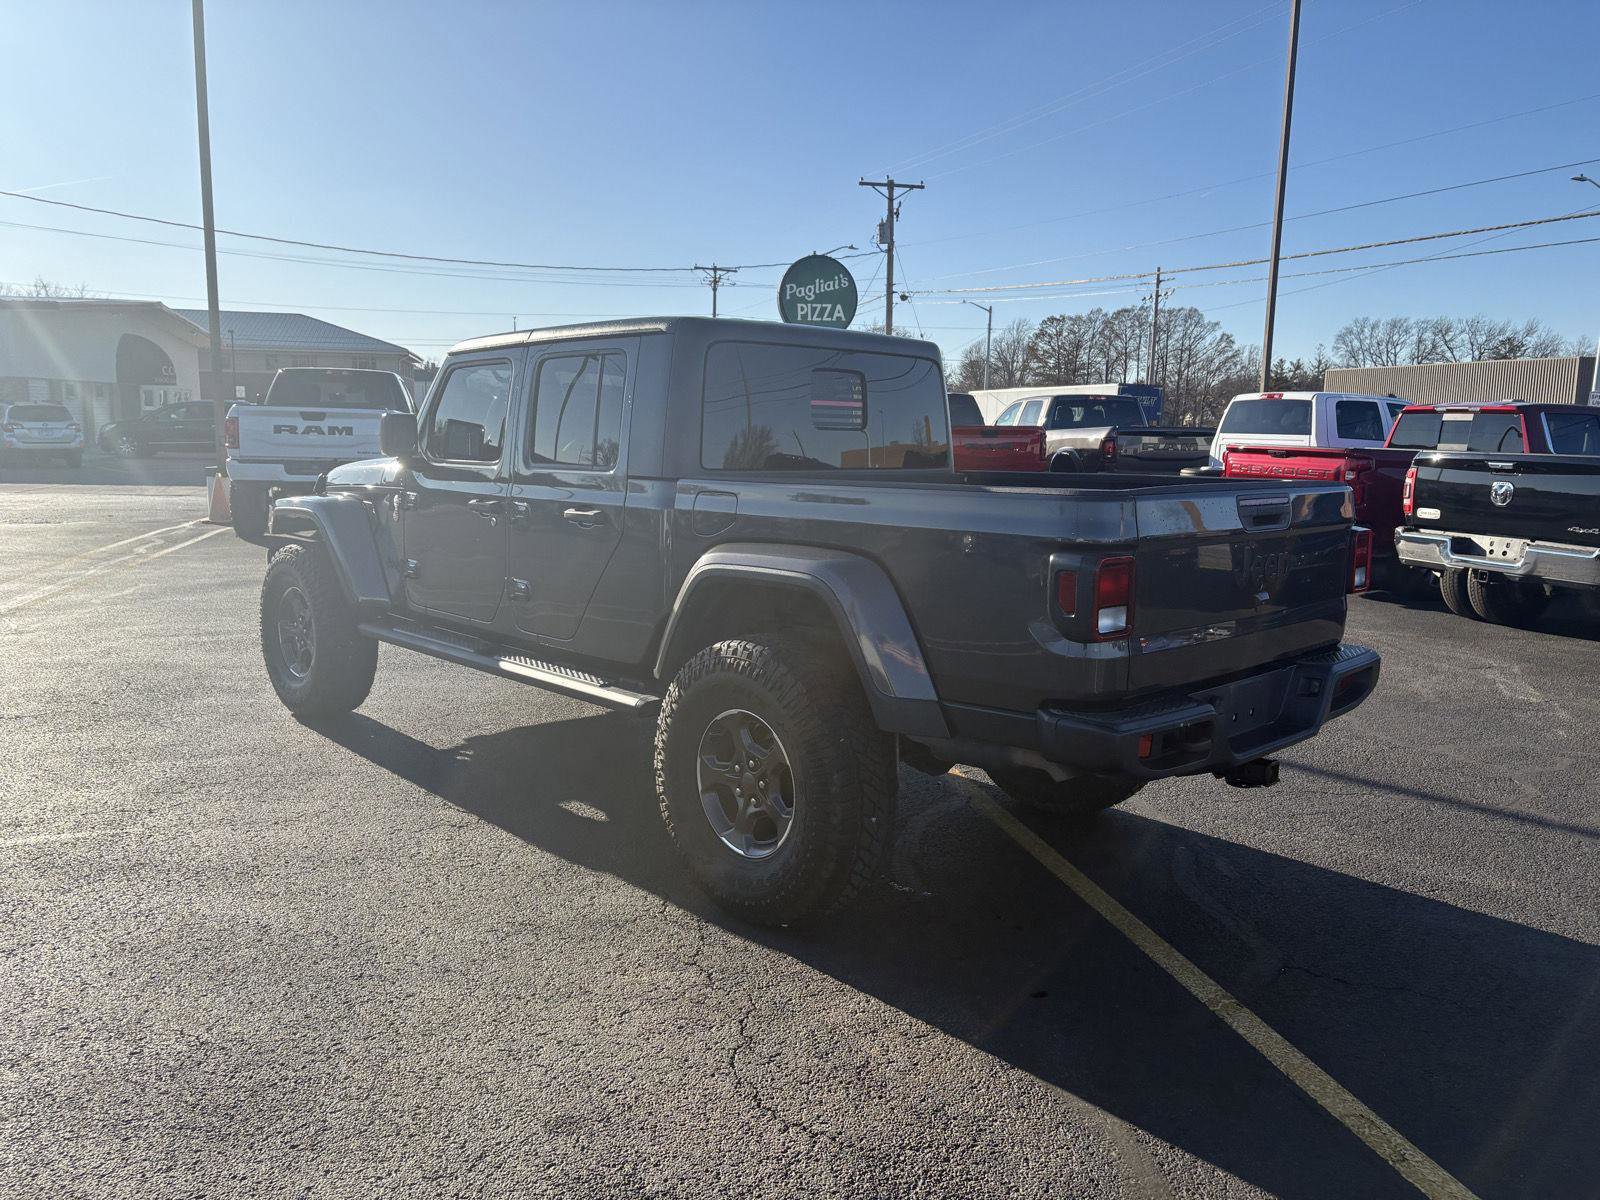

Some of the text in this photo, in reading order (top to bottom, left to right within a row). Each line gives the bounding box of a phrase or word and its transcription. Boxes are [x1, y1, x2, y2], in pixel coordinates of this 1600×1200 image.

[785, 273, 849, 301] Pagliai's
[797, 303, 846, 321] PIZZA
[272, 424, 354, 437] RAM
[1141, 442, 1199, 452] RAM
[1231, 463, 1333, 479] CHEVROLET
[1235, 546, 1290, 582] Jeep
